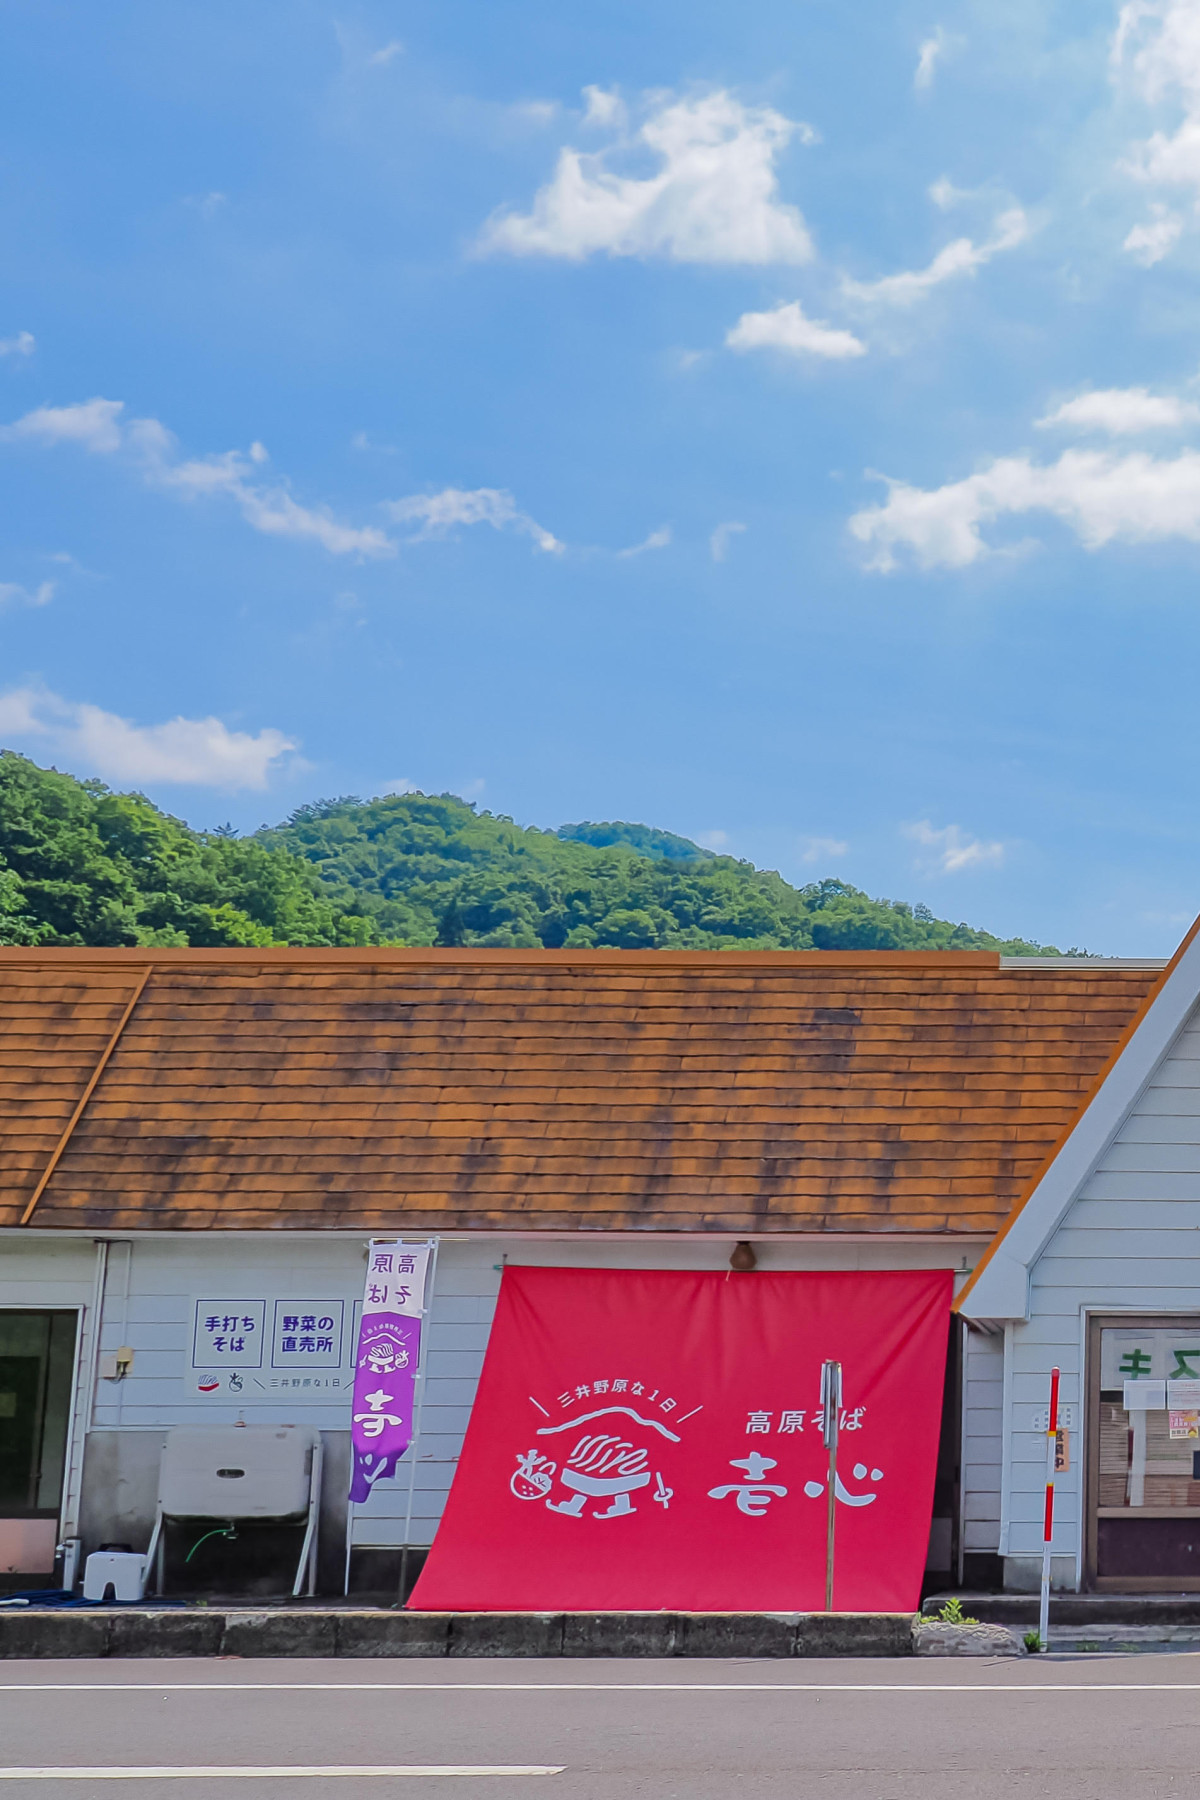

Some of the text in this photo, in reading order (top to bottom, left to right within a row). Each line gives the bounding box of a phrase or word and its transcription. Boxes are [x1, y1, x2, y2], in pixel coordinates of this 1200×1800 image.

[204, 1315, 255, 1332] 手打ち
[282, 1315, 335, 1332] 野菜の
[212, 1336, 246, 1352] そば
[281, 1336, 334, 1352] 直売所
[269, 1378, 341, 1388] 三井野原な1日
[557, 1379, 677, 1413] 三井野原な1日
